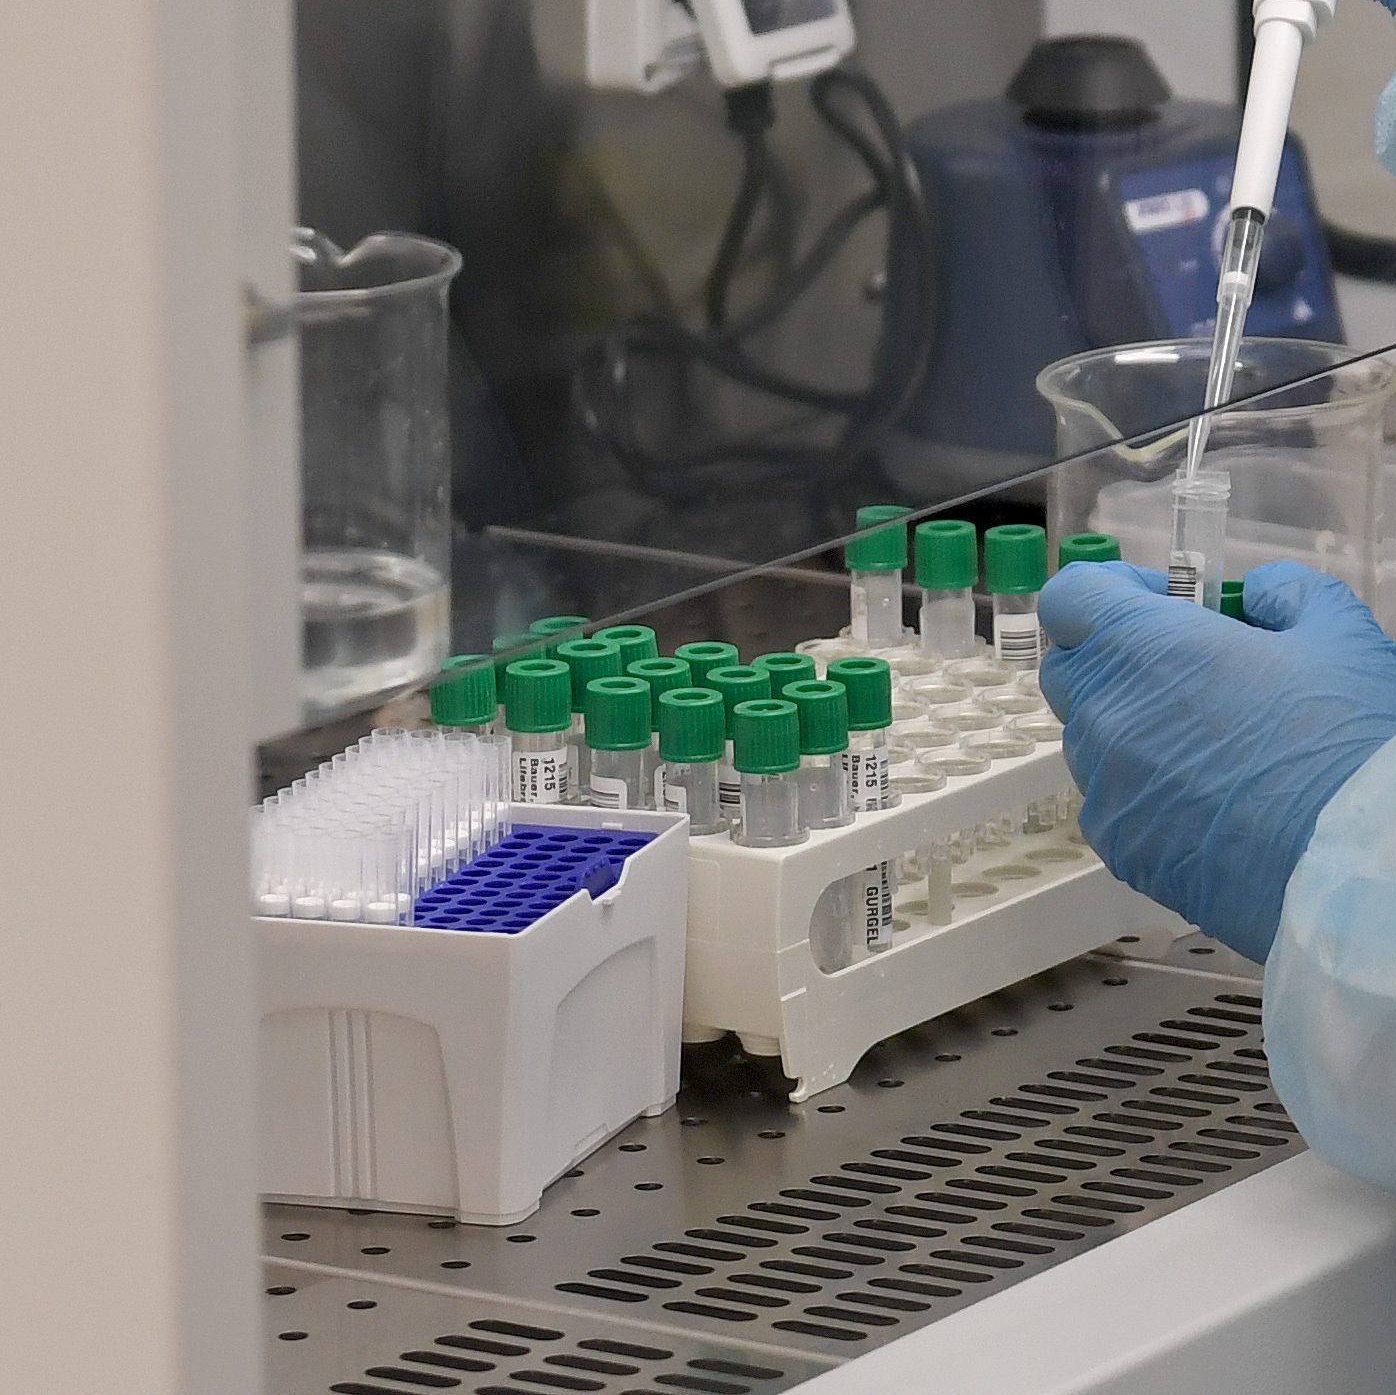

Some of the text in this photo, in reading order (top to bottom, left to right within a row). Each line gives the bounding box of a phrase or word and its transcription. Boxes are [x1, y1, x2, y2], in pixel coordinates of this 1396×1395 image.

[544, 757, 556, 791] 1215
[865, 754, 878, 788] 1215
[865, 886, 879, 945] GURGEL
